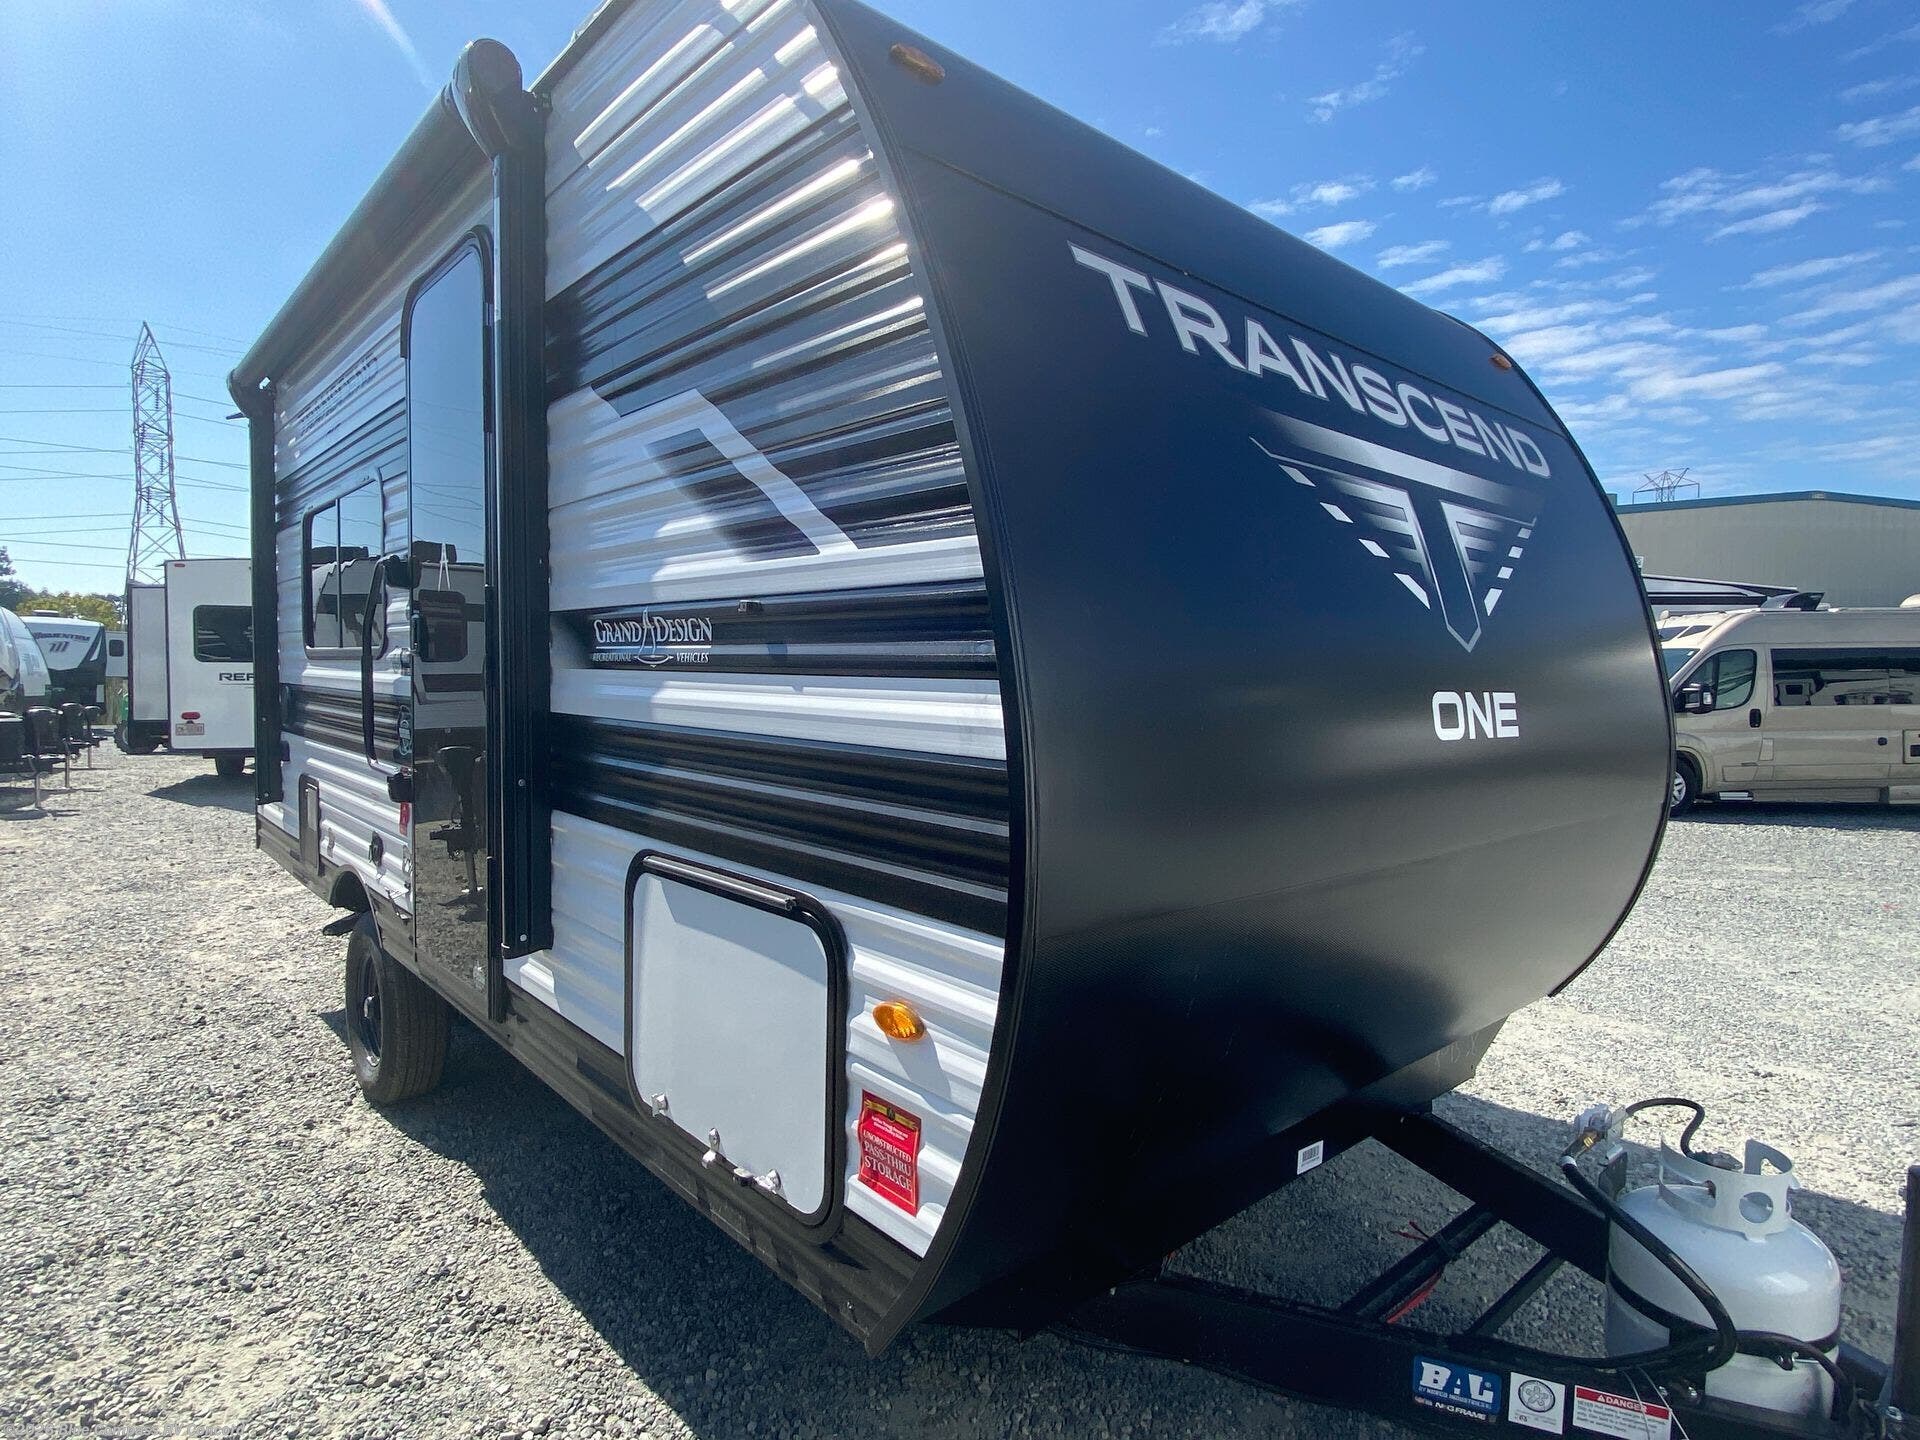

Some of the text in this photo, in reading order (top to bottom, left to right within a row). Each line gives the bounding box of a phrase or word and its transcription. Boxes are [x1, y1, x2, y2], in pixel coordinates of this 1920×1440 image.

[1067, 240, 1551, 478] TRANSCEND
[594, 616, 712, 643] GRAND DESIGN
[676, 652, 709, 663] VEHICLES
[1432, 691, 1520, 741] ONE
[863, 1130, 912, 1163] UNOBSTRUCTED
[864, 1141, 912, 1176] PASS-THRU
[864, 1155, 913, 1191] STORAGE
[1605, 1396, 1648, 1413] DANGER
